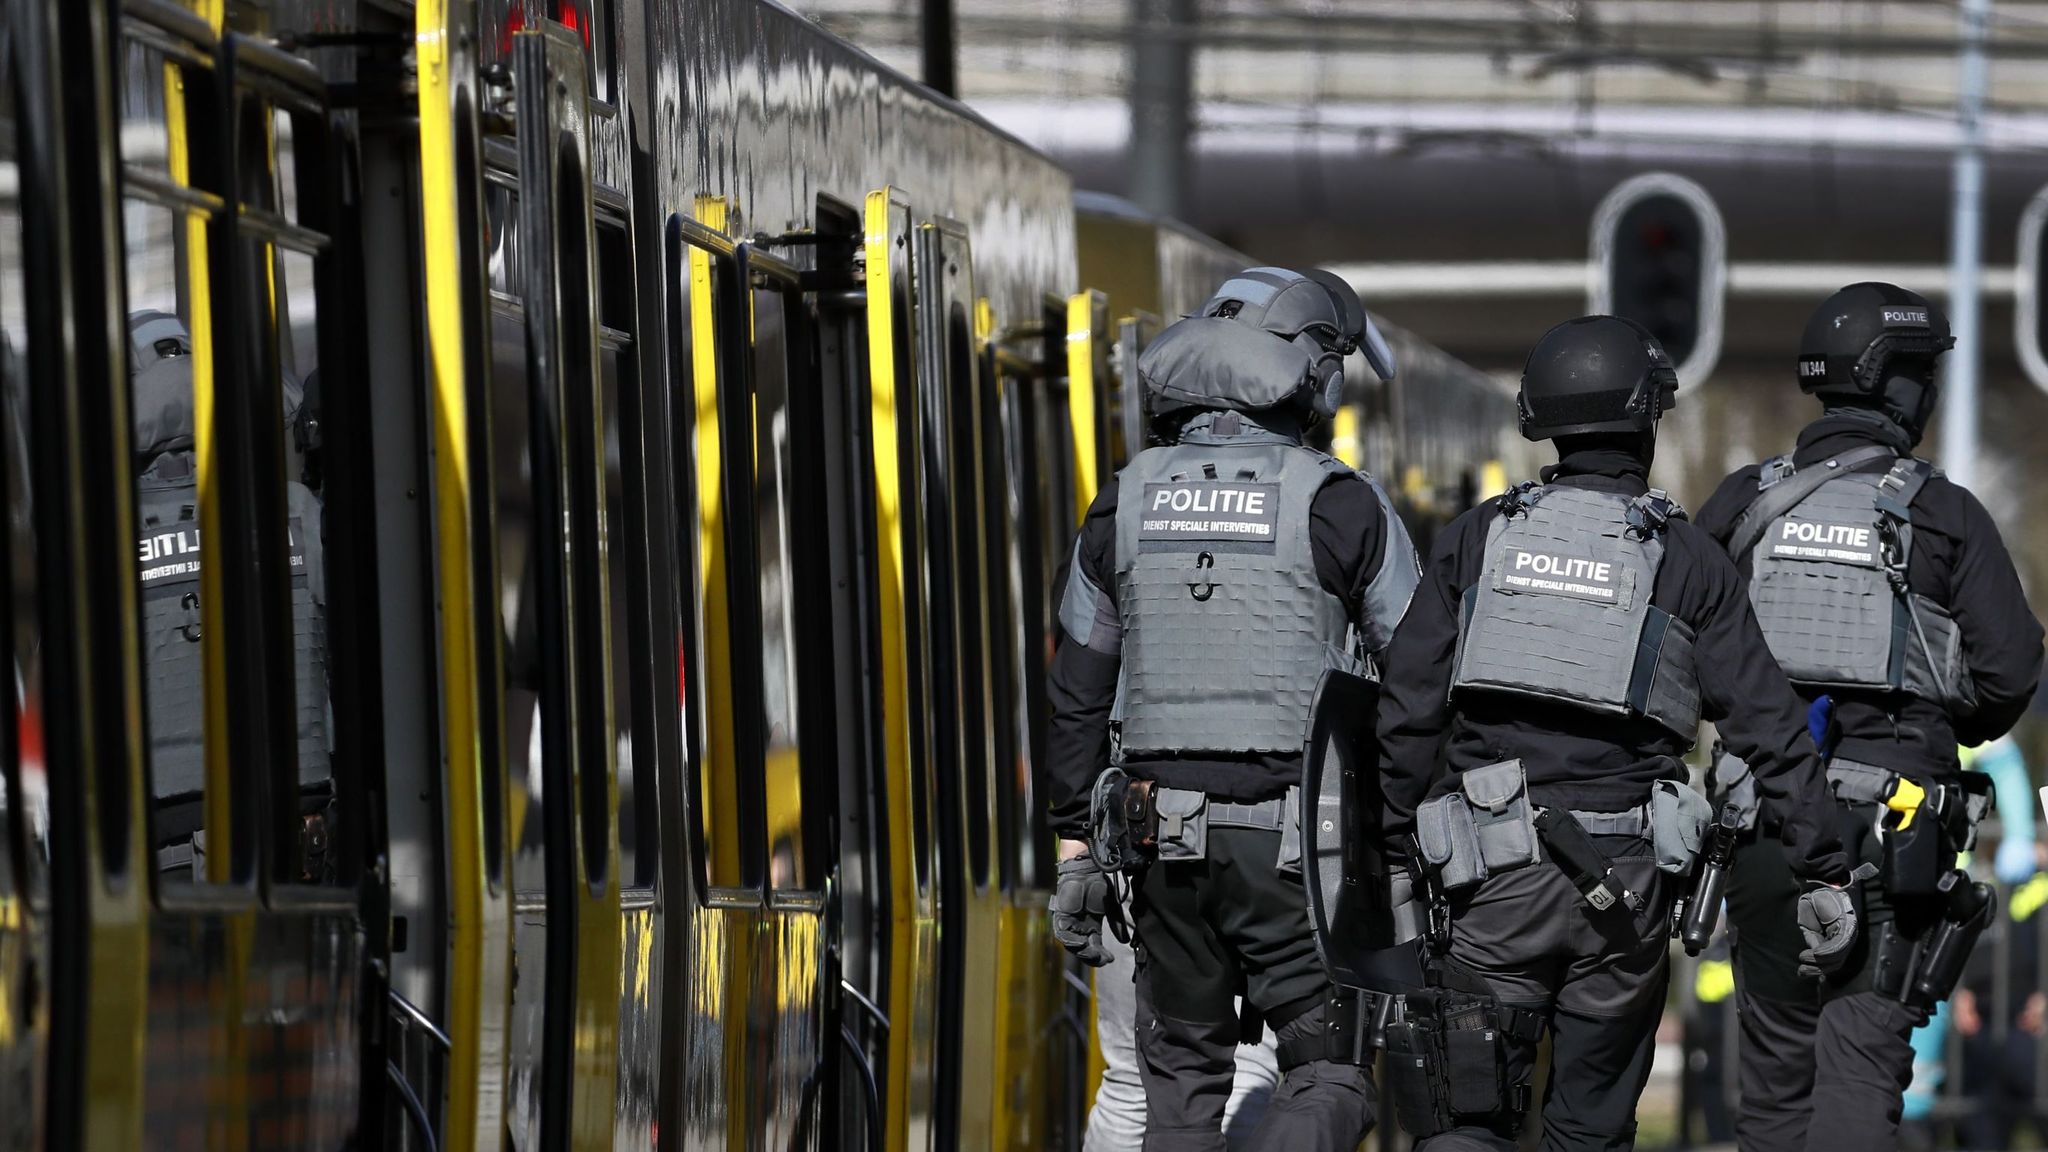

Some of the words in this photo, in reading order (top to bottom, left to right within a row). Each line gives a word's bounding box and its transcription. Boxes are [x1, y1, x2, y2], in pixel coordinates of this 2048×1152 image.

[1884, 311, 1928, 323] POLITIE
[1152, 488, 1266, 515] POLITIE
[1143, 519, 1170, 531] DIENST
[1170, 520, 1209, 532] SPECIALE
[1210, 521, 1270, 535] INTERVENTIES
[1782, 522, 1870, 547] POLITIE
[1515, 551, 1611, 582] POLITIE
[1505, 574, 1532, 587] DIENST
[1531, 578, 1564, 591] SPECIALE
[1564, 582, 1614, 598] INTERVENTIES
